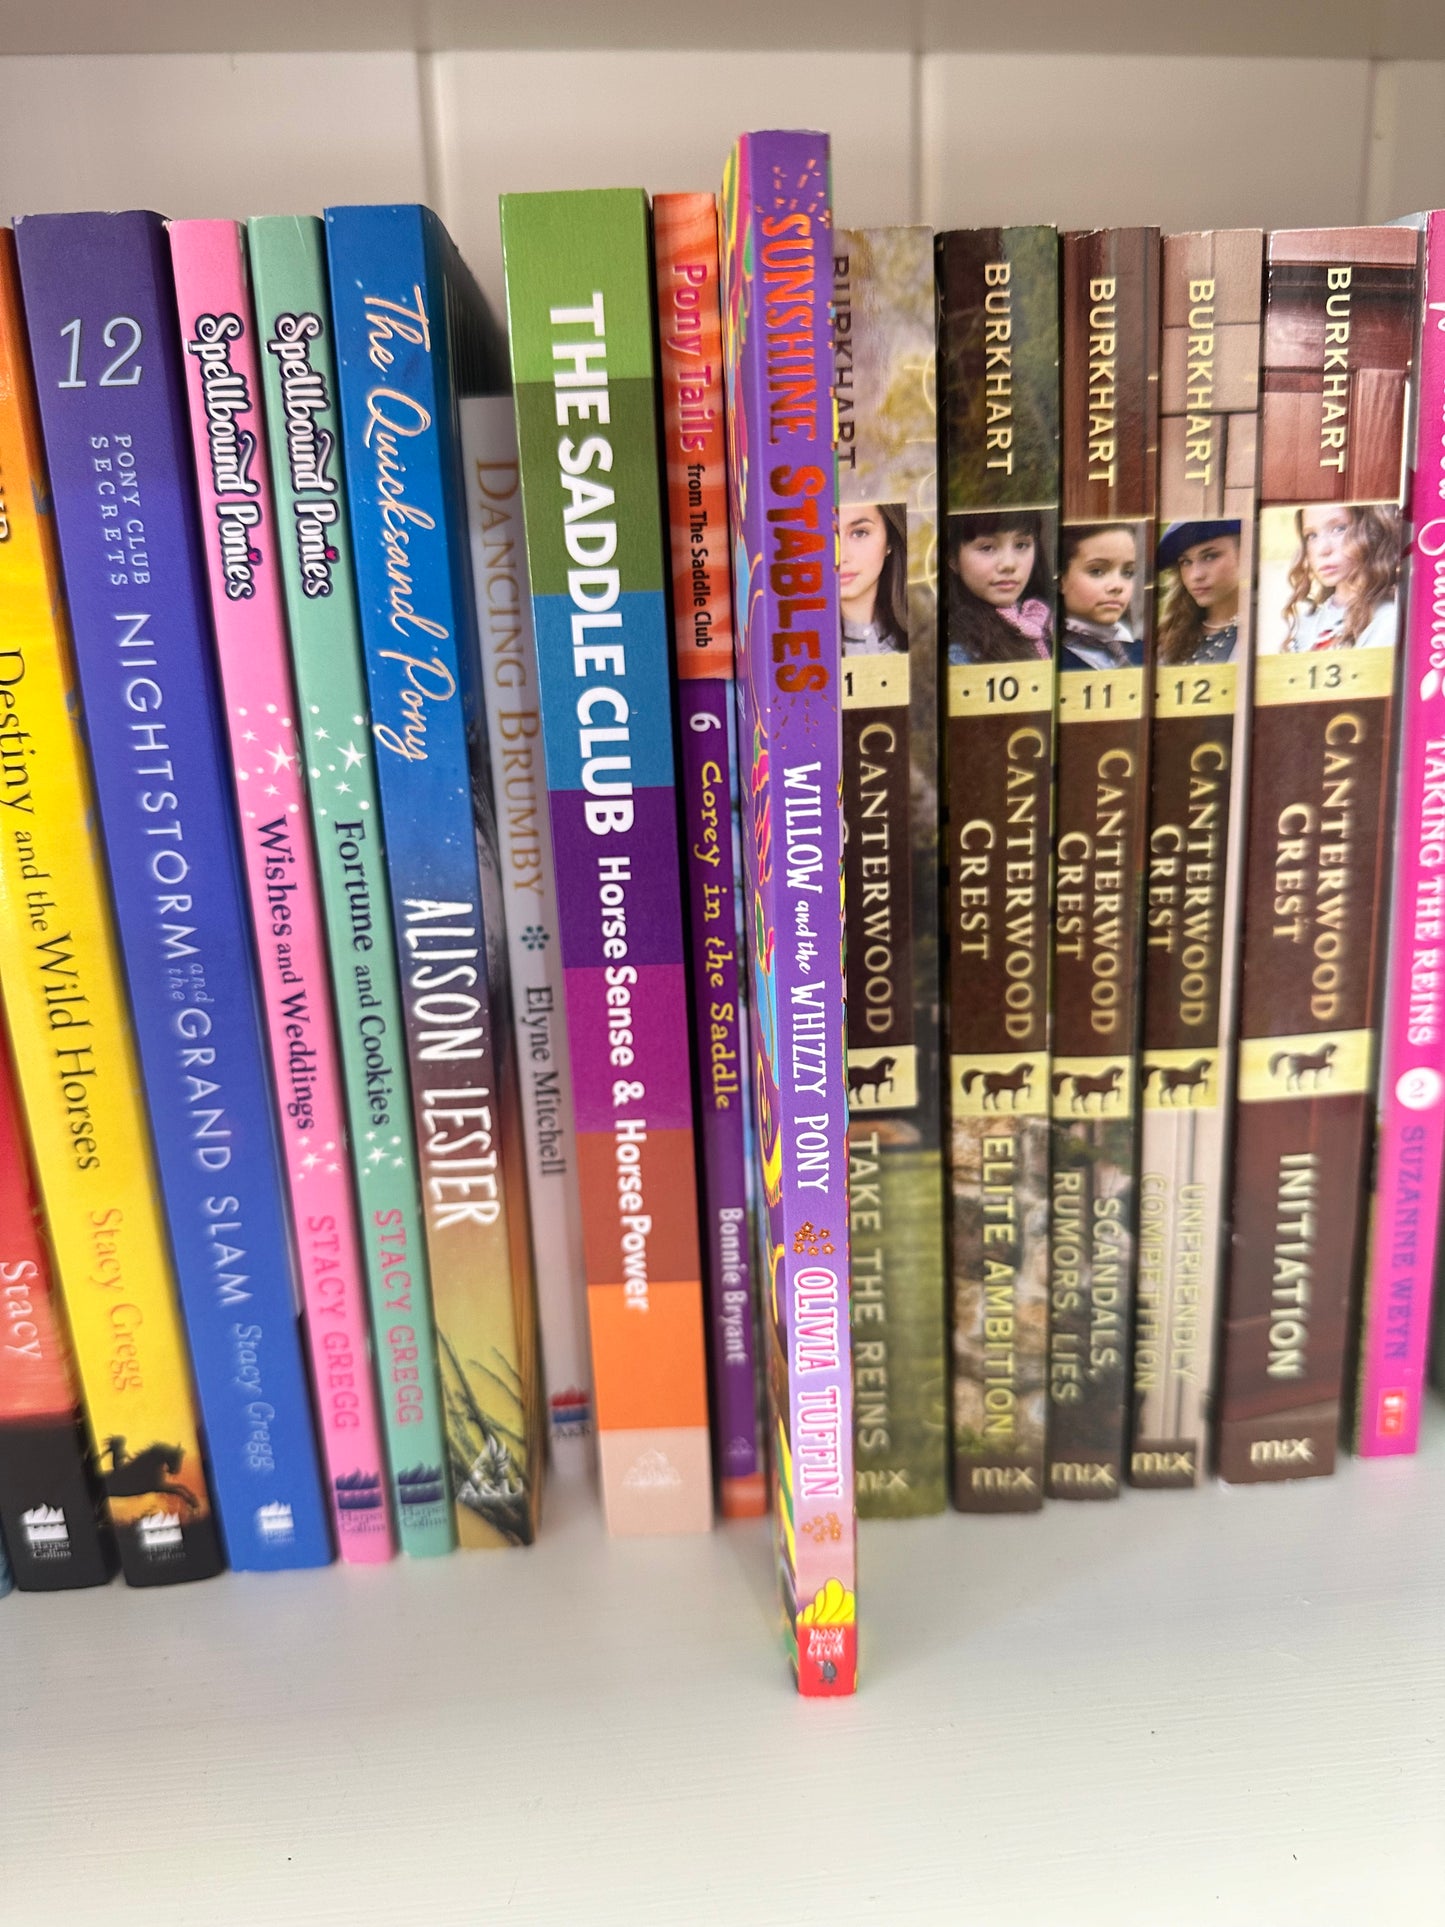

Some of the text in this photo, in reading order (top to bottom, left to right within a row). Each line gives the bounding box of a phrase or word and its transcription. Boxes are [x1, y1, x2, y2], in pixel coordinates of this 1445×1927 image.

[57, 316, 143, 389] 12
[184, 312, 263, 601] Spellbound Ponies
[265, 312, 339, 599] Spellbound Ponies
[666, 264, 713, 648] Pony Tails from The Saddle Club
[760, 213, 829, 694] SUNSHINE STABLES
[984, 262, 1012, 475] BURKHART
[1088, 277, 1117, 487] BURKHART
[1183, 279, 1216, 487] BURKHART
[1319, 266, 1352, 474] BURKHART
[90, 436, 129, 587] SECRETS
[113, 434, 151, 586] PONY CLUB
[363, 285, 457, 763] The Quicksand Pony
[549, 292, 635, 837] THE SADDLE CLUB
[476, 457, 544, 897] DANCING BRUMBY
[986, 677, 1018, 702] 10
[1082, 684, 1113, 709] 11
[1175, 679, 1213, 705] 12
[1308, 665, 1342, 690] 13
[115, 613, 200, 960] NIGHTSTORM
[858, 723, 896, 1034] CANTERWOOD
[959, 819, 995, 961] CREST
[1005, 726, 1047, 1039] CANTERWOOD
[1090, 749, 1134, 1034] CANTERWOOD
[1147, 825, 1184, 954] CREST
[1179, 742, 1227, 1027] CANTERWOOD
[1272, 802, 1314, 943] CREST
[1310, 712, 1366, 1022] CANTERWOOD
[1408, 735, 1445, 1046] TAKING THE REINS
[0, 648, 100, 1172] Destiny and the Wild Horses
[168, 967, 189, 1001] the
[190, 963, 214, 1003] and
[257, 815, 316, 1130] Wishes and Weddings
[335, 819, 391, 1126] Fortune and Cookies
[689, 713, 739, 1110] 6 Corey in the Saddle
[783, 762, 830, 1193] WILLOW and the WHIZZY PONY
[1056, 831, 1093, 961] CREST
[177, 1008, 252, 1307] GRAND SLAM
[402, 899, 500, 1229] ALISON LESTER
[526, 985, 567, 1178] Elyne Mitchell
[598, 856, 652, 1313] Horse Sense & Horse Power
[1409, 1078, 1425, 1100] 2
[88, 1207, 144, 1393] Stacy Gregg
[719, 1207, 748, 1365] Bonnie Bryant
[849, 1132, 889, 1450] TAKE THE REINS
[982, 1134, 1017, 1435] ELITE AMBITION
[1134, 1172, 1168, 1392] COMPETITION
[1169, 1183, 1205, 1384] UNFRIENDLY
[1266, 1152, 1318, 1379] INITIATION
[1391, 1125, 1425, 1269] SUZANNE
[0, 1259, 42, 1359] Stacy
[231, 1323, 276, 1471] Stacy Gregg
[307, 1215, 360, 1430] STACY GREGG
[373, 1209, 424, 1425] STACY GREGG
[793, 1267, 843, 1500] OLIVIA TUFFIN
[1051, 1332, 1079, 1406] LIES
